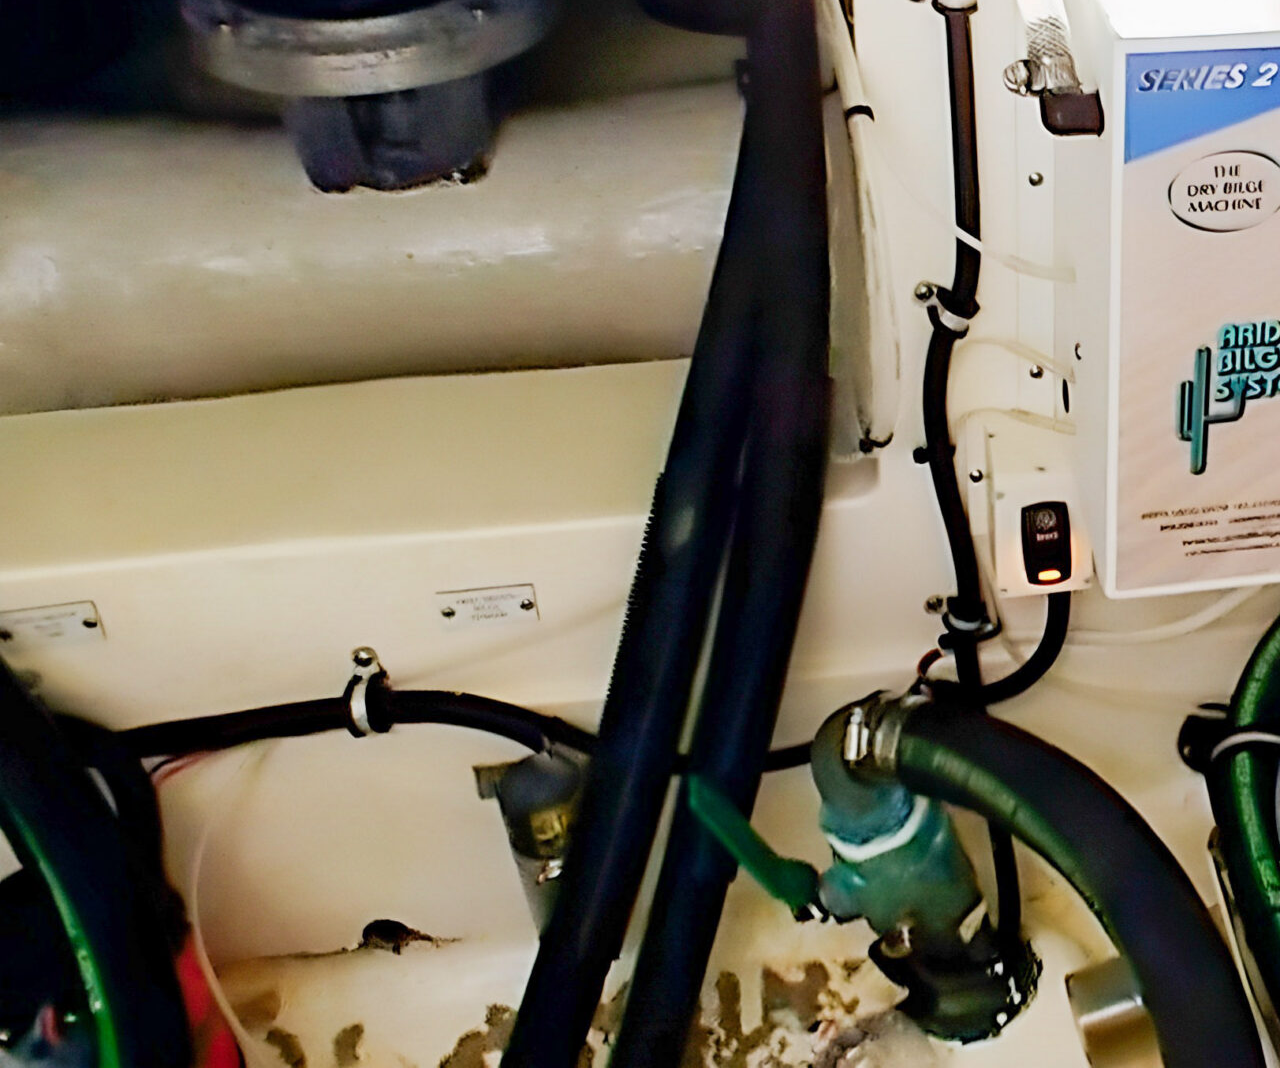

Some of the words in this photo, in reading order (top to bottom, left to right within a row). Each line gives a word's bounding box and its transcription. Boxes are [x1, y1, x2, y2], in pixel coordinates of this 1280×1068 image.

[1136, 63, 1248, 93] SERIES
[1251, 62, 1279, 87] 2
[1213, 164, 1242, 179] THE
[1187, 183, 1218, 198] DRY
[1223, 179, 1265, 195] BILGE
[1187, 197, 1263, 213] MACHINE
